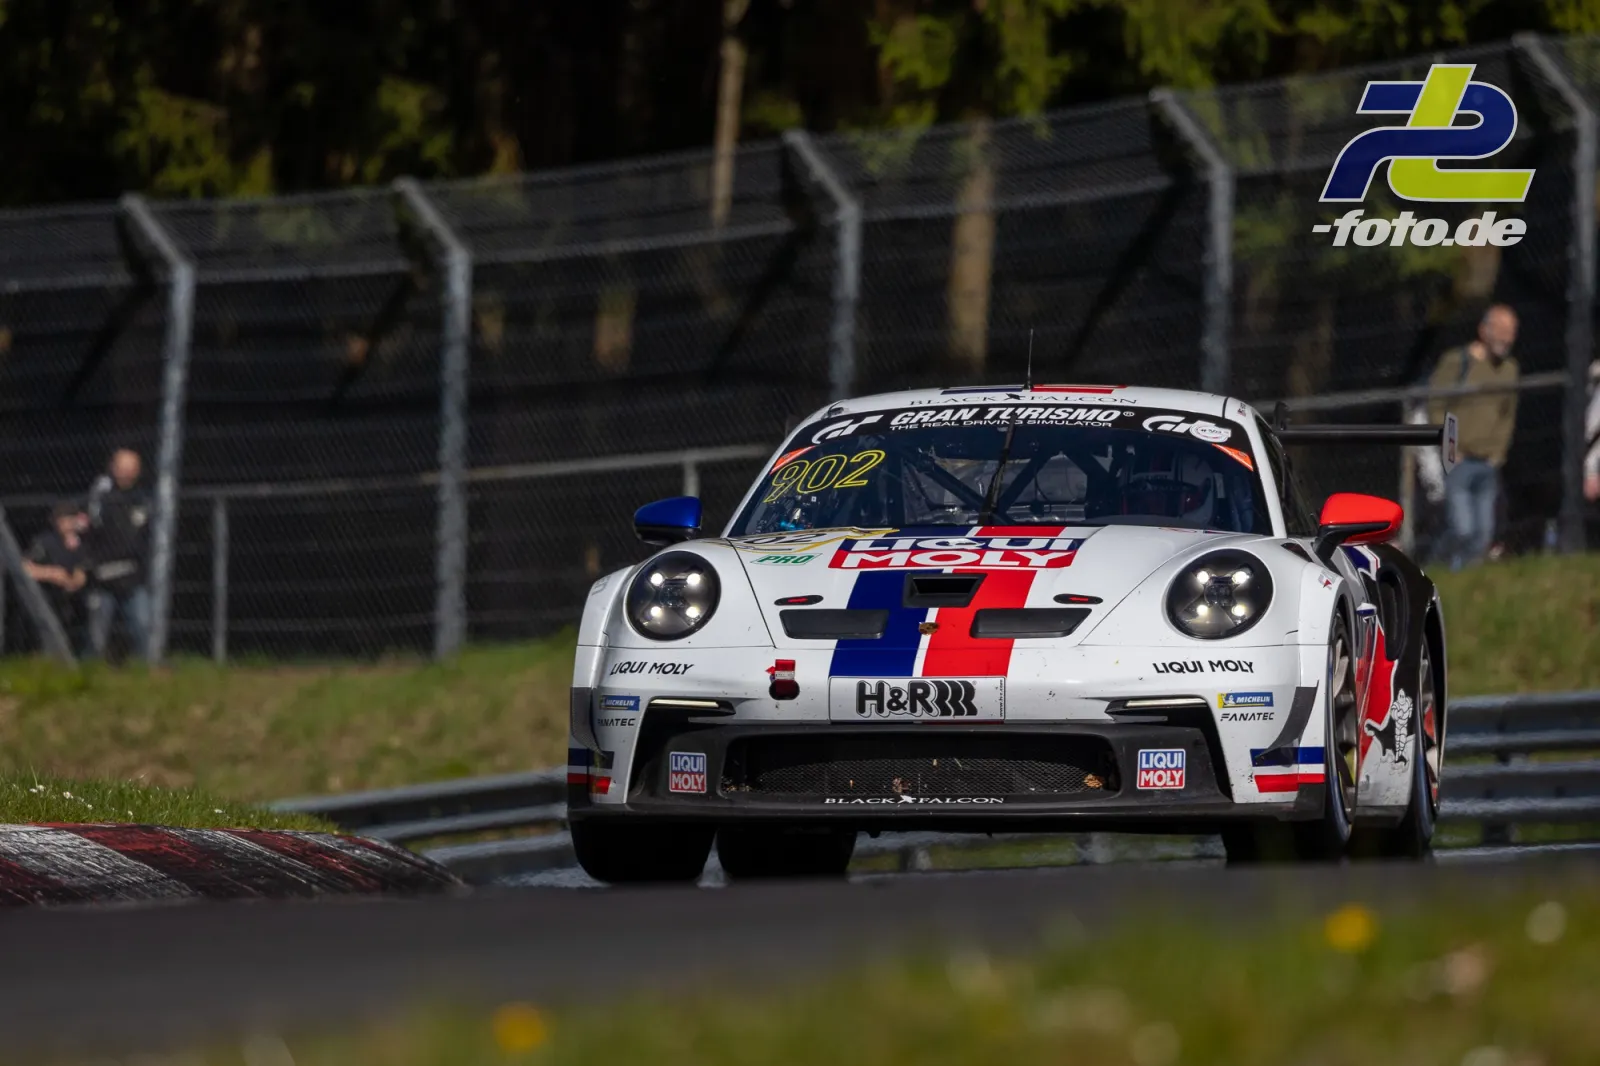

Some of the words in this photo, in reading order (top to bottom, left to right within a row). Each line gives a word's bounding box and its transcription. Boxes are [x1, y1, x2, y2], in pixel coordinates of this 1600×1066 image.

[910, 396, 996, 406] BLACK
[1026, 393, 1136, 404] FALCON
[890, 408, 980, 425] GRAN
[983, 406, 1121, 421] TURISMO
[1027, 419, 1112, 427] SIMULATOR
[763, 450, 886, 503] 902
[850, 538, 1077, 551] LIQUI
[757, 555, 815, 564] PRO
[841, 551, 1073, 567] MOLY
[610, 661, 648, 676] LIQUI
[648, 662, 695, 675] MOLY
[1152, 660, 1205, 674] LIQUI
[1208, 659, 1255, 674] MOLY
[1236, 695, 1271, 704] MICHELIN
[1220, 712, 1275, 722] FANATEC
[671, 756, 704, 772] LIQUI
[1140, 752, 1183, 769] LIQUI
[671, 774, 705, 790] MOLY
[1140, 770, 1183, 787] MOLY
